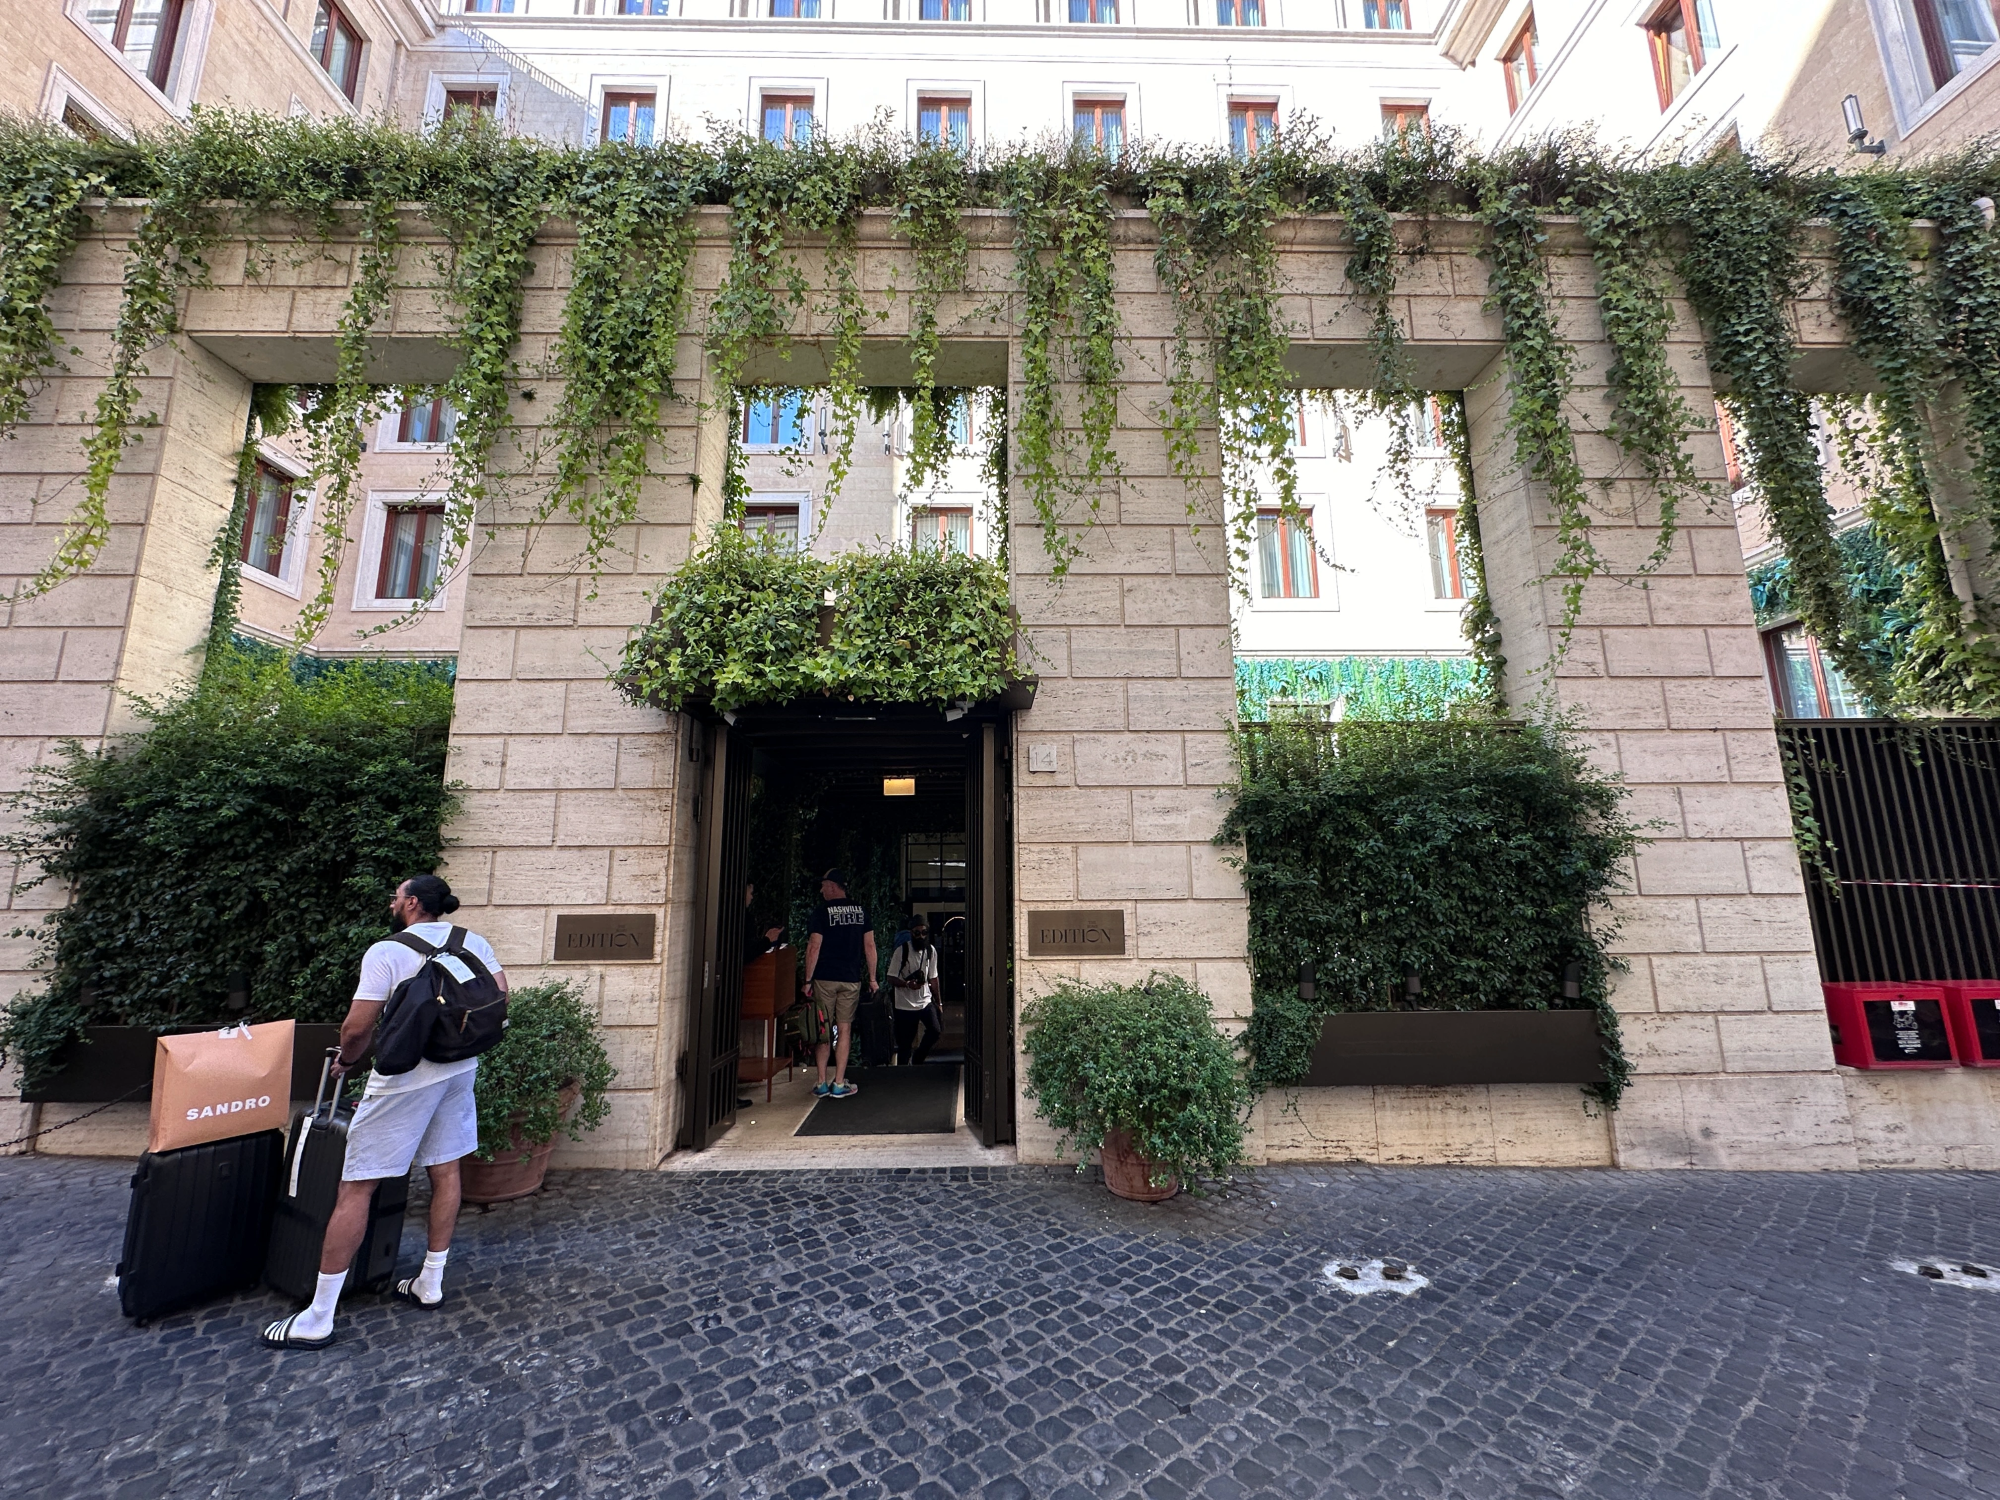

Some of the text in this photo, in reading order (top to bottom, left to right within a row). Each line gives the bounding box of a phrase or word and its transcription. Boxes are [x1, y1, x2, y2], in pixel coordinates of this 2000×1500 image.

[1034, 751, 1053, 766] 14
[827, 905, 863, 914] NASHVILLE
[829, 911, 865, 927] FIRE
[567, 933, 642, 947] EDITION
[1040, 929, 1114, 943] EDITION
[186, 1095, 271, 1120] SANDRO
